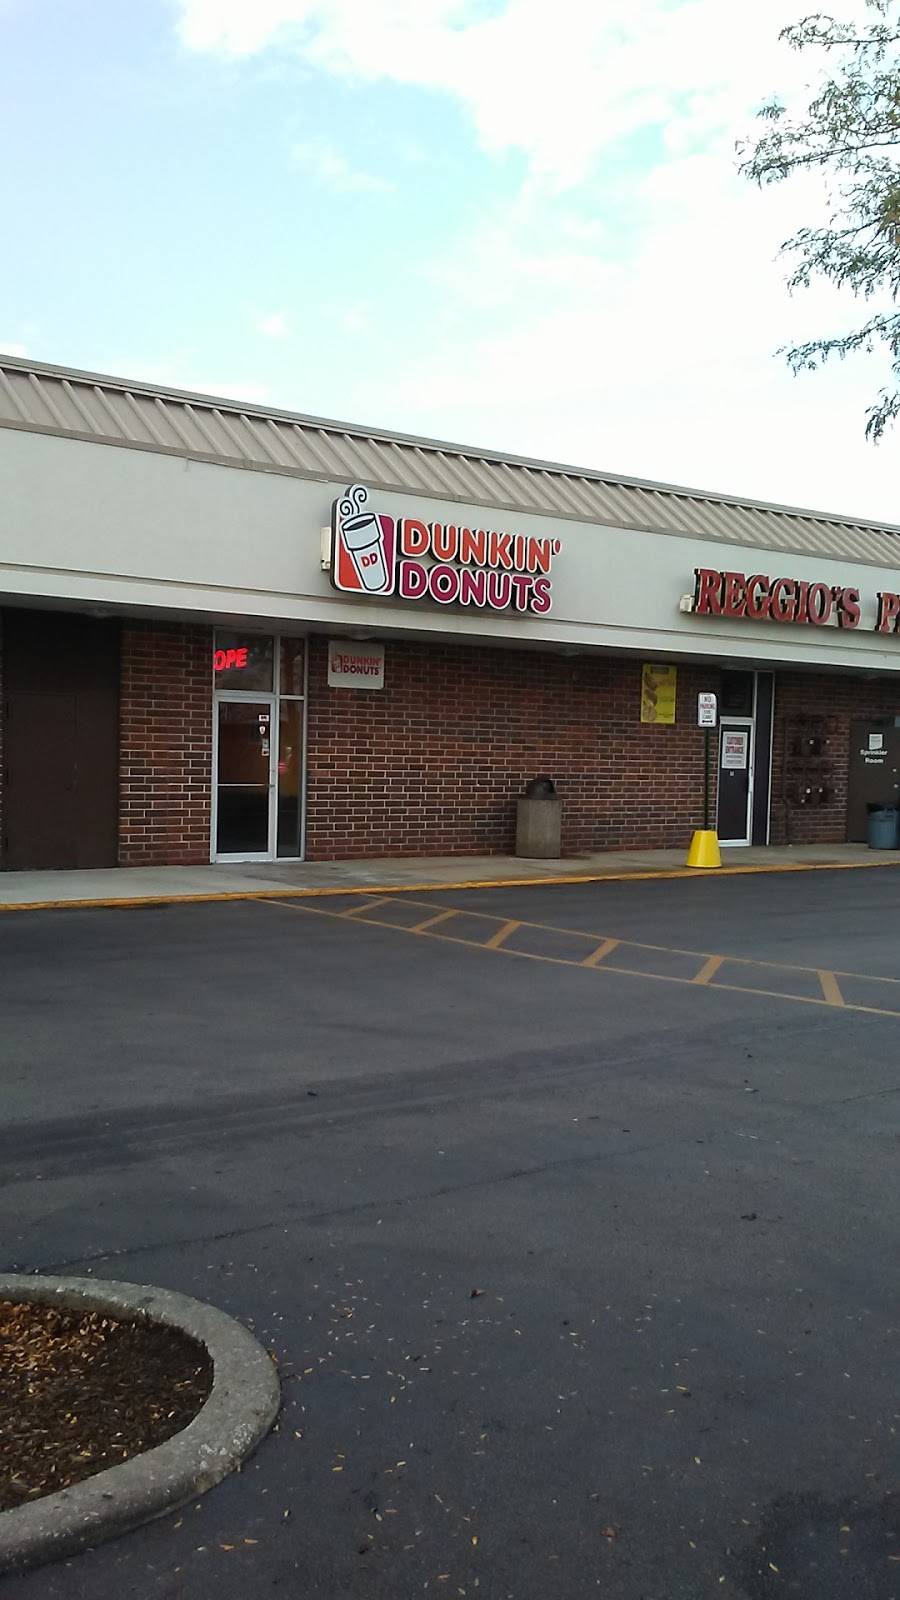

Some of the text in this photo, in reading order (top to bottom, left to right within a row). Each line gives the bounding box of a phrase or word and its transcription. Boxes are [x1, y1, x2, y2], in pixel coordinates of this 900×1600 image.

[360, 552, 378, 568] DD
[398, 518, 561, 574] DUNKIN'
[397, 560, 552, 614] DONUTS
[694, 568, 900, 634] REGGIO'S P
[343, 664, 380, 675] DONUTS
